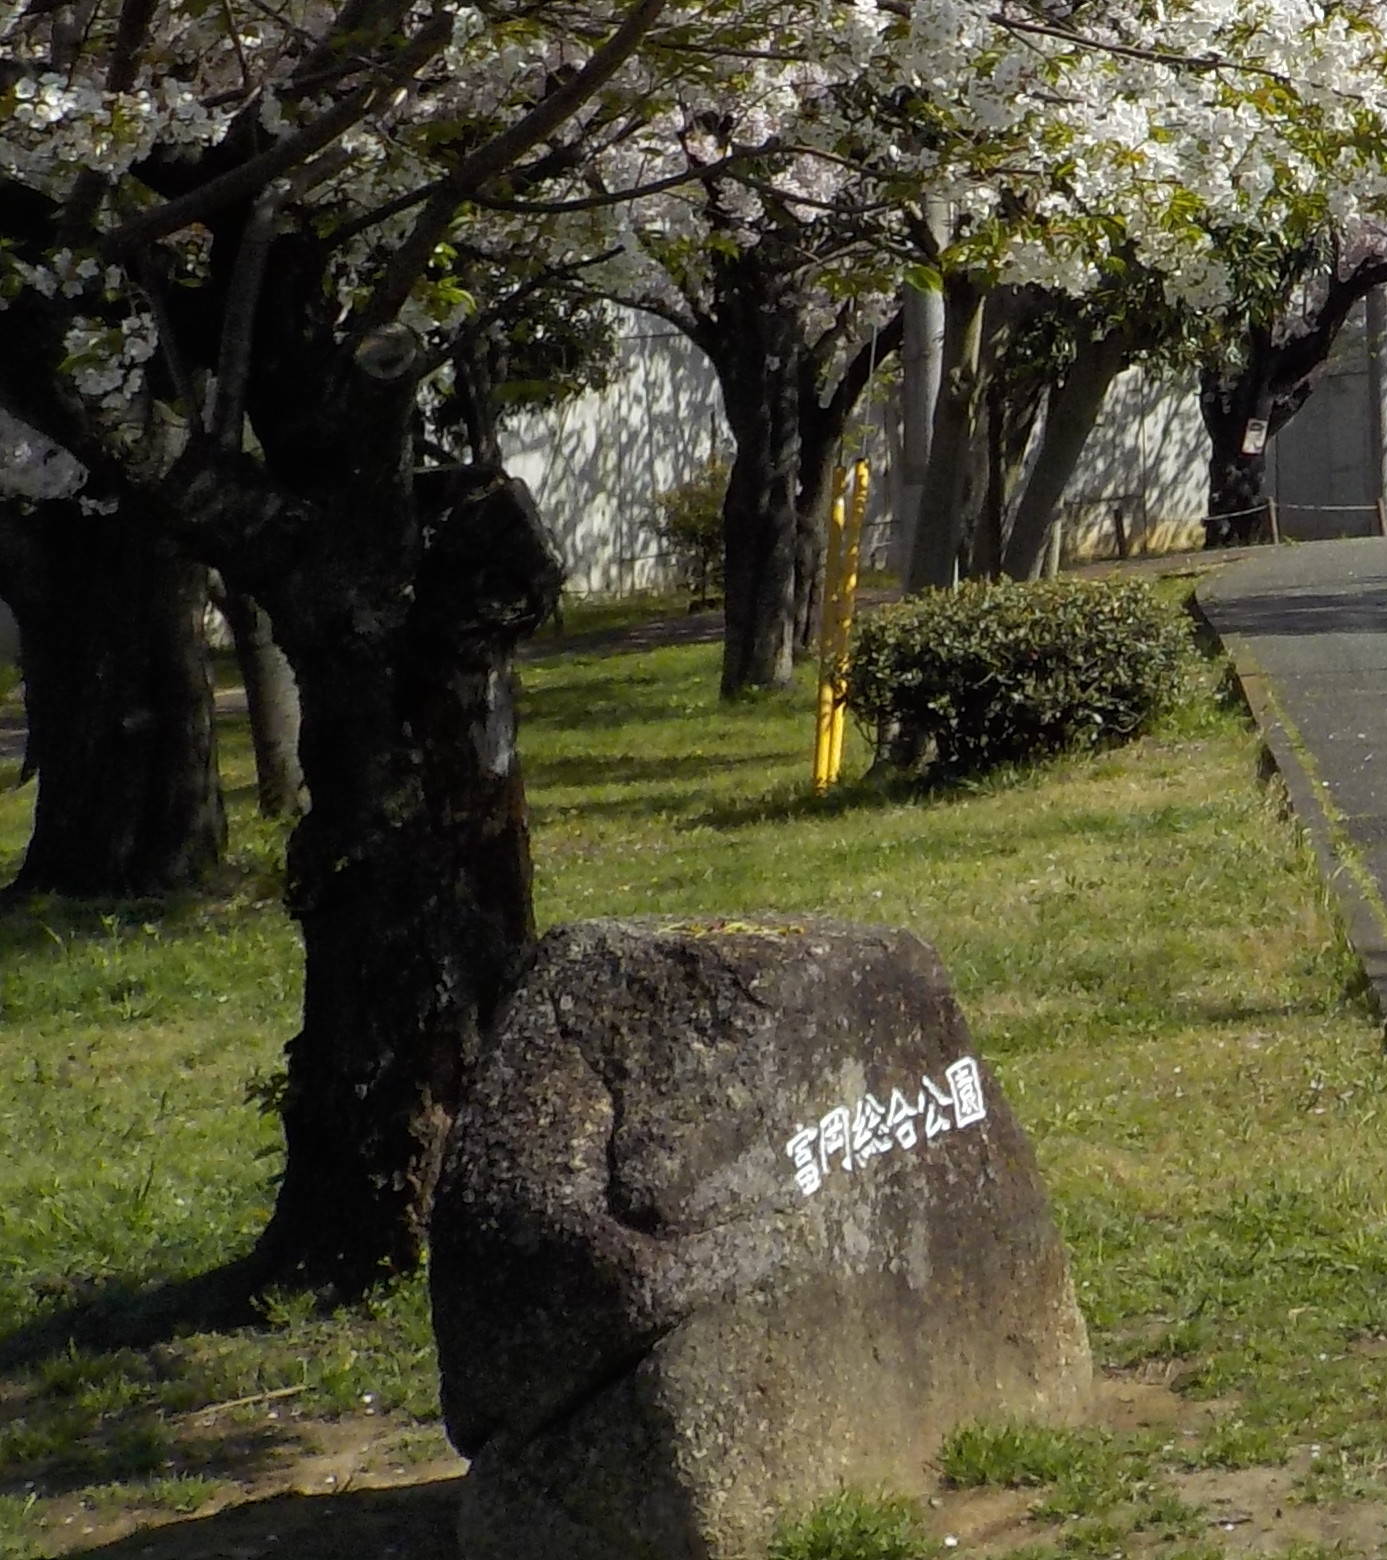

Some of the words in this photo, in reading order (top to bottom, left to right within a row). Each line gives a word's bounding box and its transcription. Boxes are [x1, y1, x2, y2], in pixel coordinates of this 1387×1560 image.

[785, 1055, 987, 1197] 富岡総合公園
